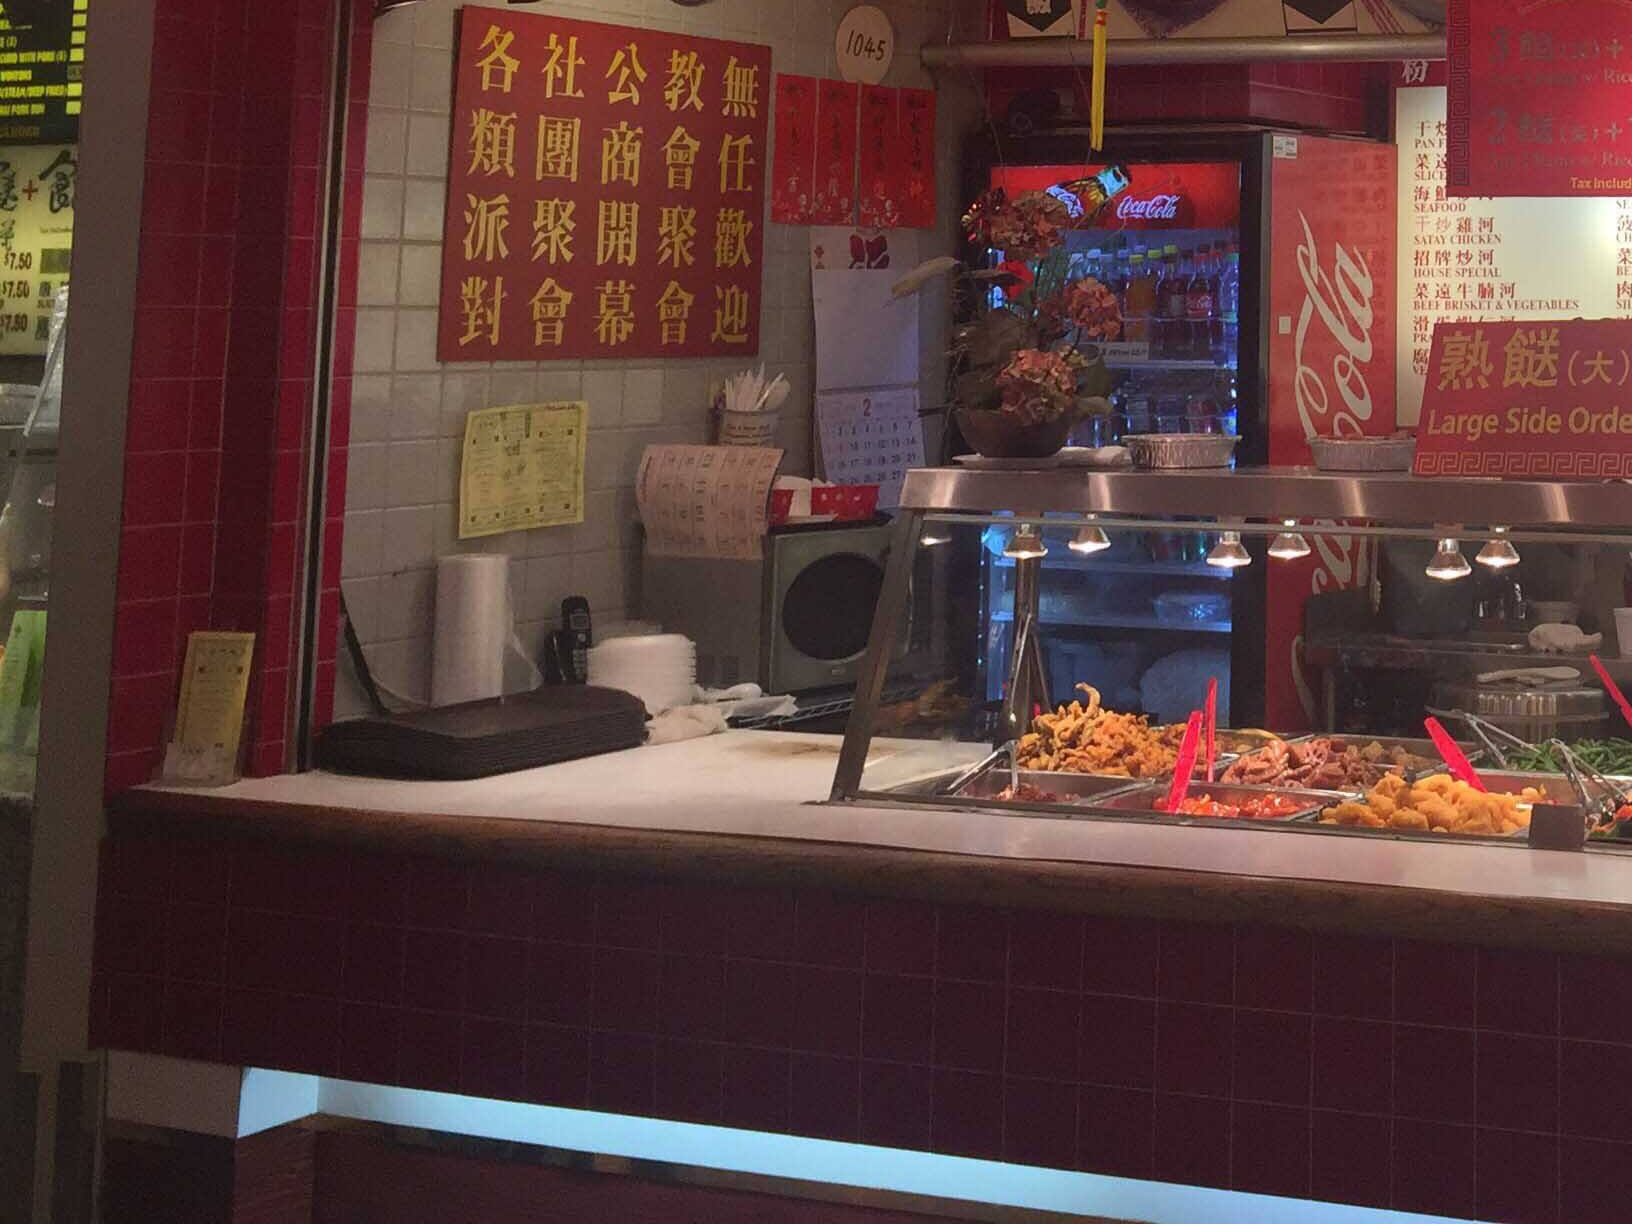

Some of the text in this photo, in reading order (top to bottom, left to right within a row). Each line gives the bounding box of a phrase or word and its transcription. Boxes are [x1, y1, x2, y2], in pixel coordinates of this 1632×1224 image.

[847, 29, 886, 61] 1045
[457, 24, 521, 347] 各類派對
[529, 33, 586, 346] 社團聚會
[1569, 177, 1592, 190] Tax
[592, 41, 648, 346] 公商開幕
[656, 48, 705, 345] 教會聚會
[710, 55, 760, 345] 無任歡迎
[1414, 203, 1467, 214] SEAFOOD
[1414, 233, 1502, 246] SATAY CHICKEN
[4, 252, 32, 271] $7.50
[1414, 249, 1495, 266] 招牌炒河
[1413, 267, 1502, 278] HOUSE SPECIAL
[2, 280, 30, 299] $7.50
[1413, 299, 1580, 311] BEEF BRISKET & VEGETABLES
[1427, 408, 1499, 441] Large
[1504, 406, 1562, 434] Side
